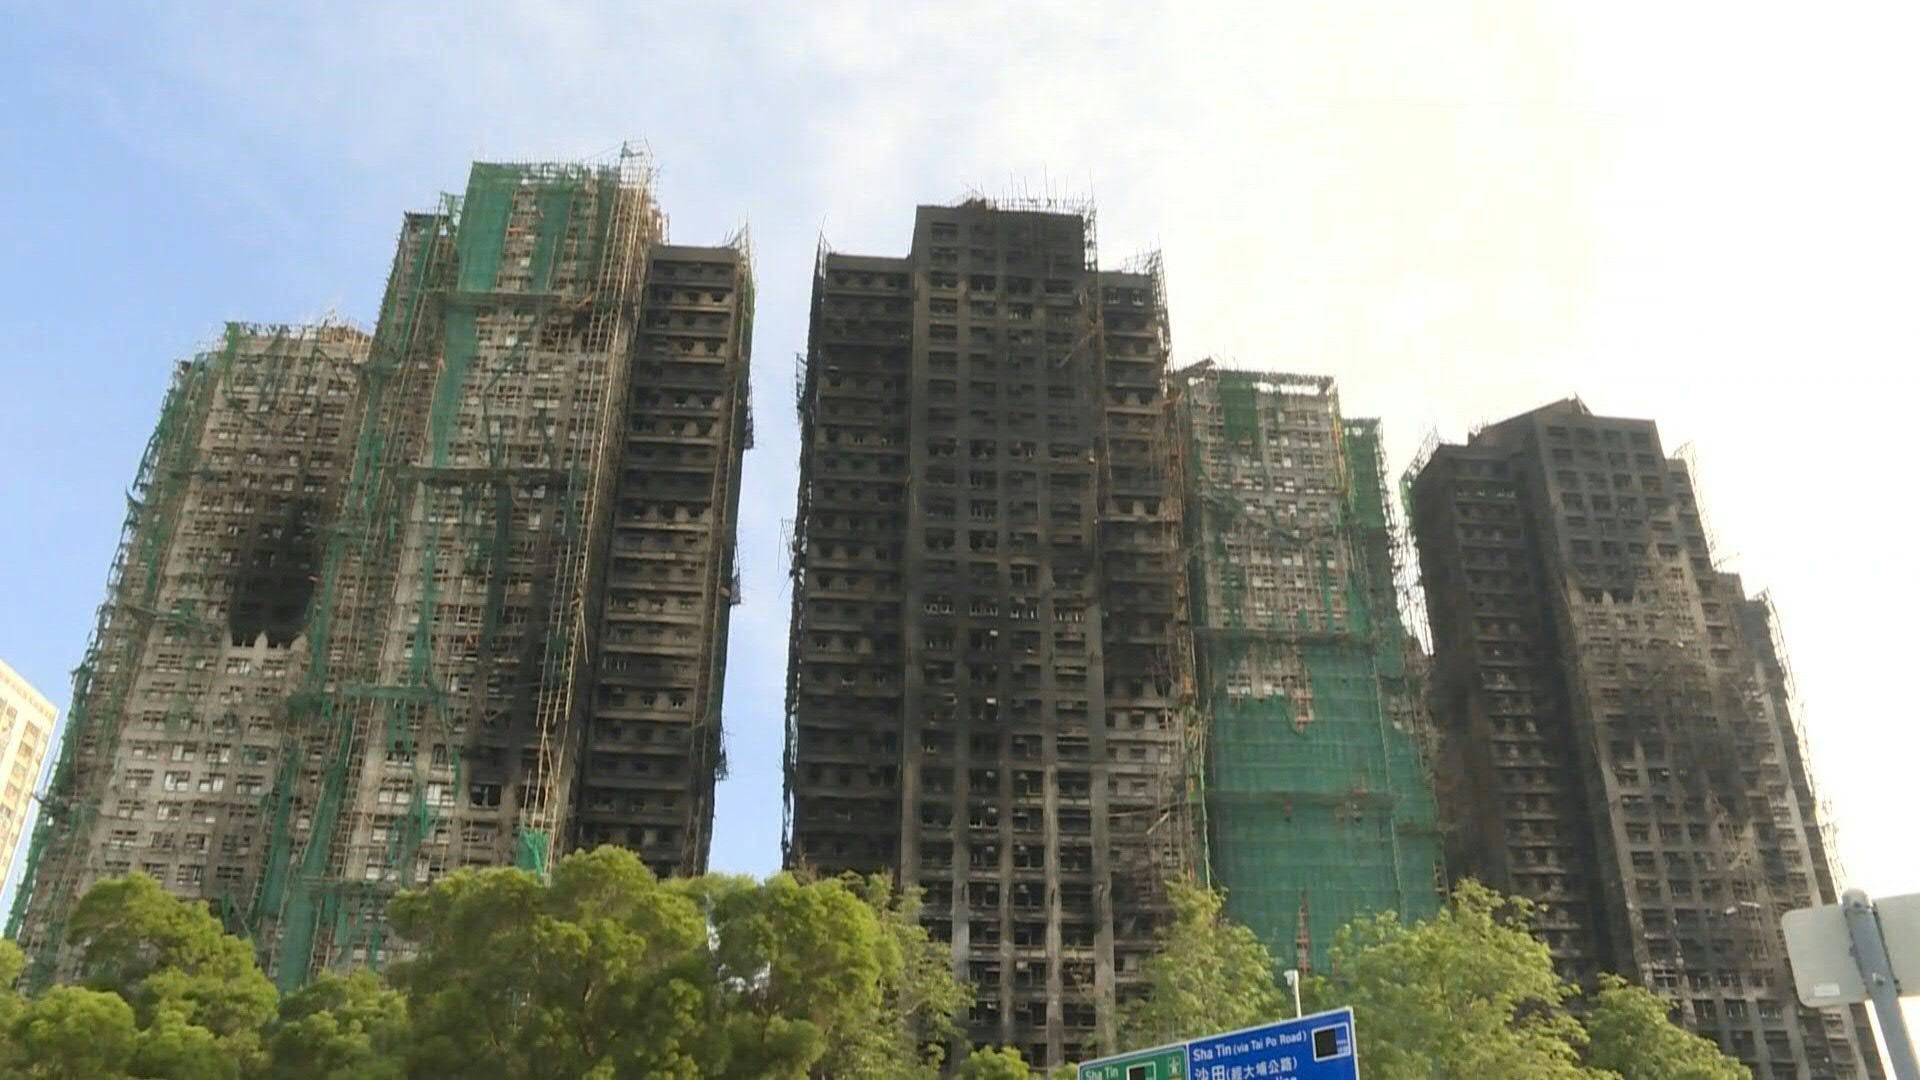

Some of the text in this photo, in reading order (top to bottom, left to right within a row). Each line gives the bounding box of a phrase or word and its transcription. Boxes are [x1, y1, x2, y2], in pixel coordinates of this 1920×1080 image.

[1193, 1029, 1307, 1061] Sha Tin (via Tai Po Road)
[1086, 1065, 1119, 1080] Sha Tin
